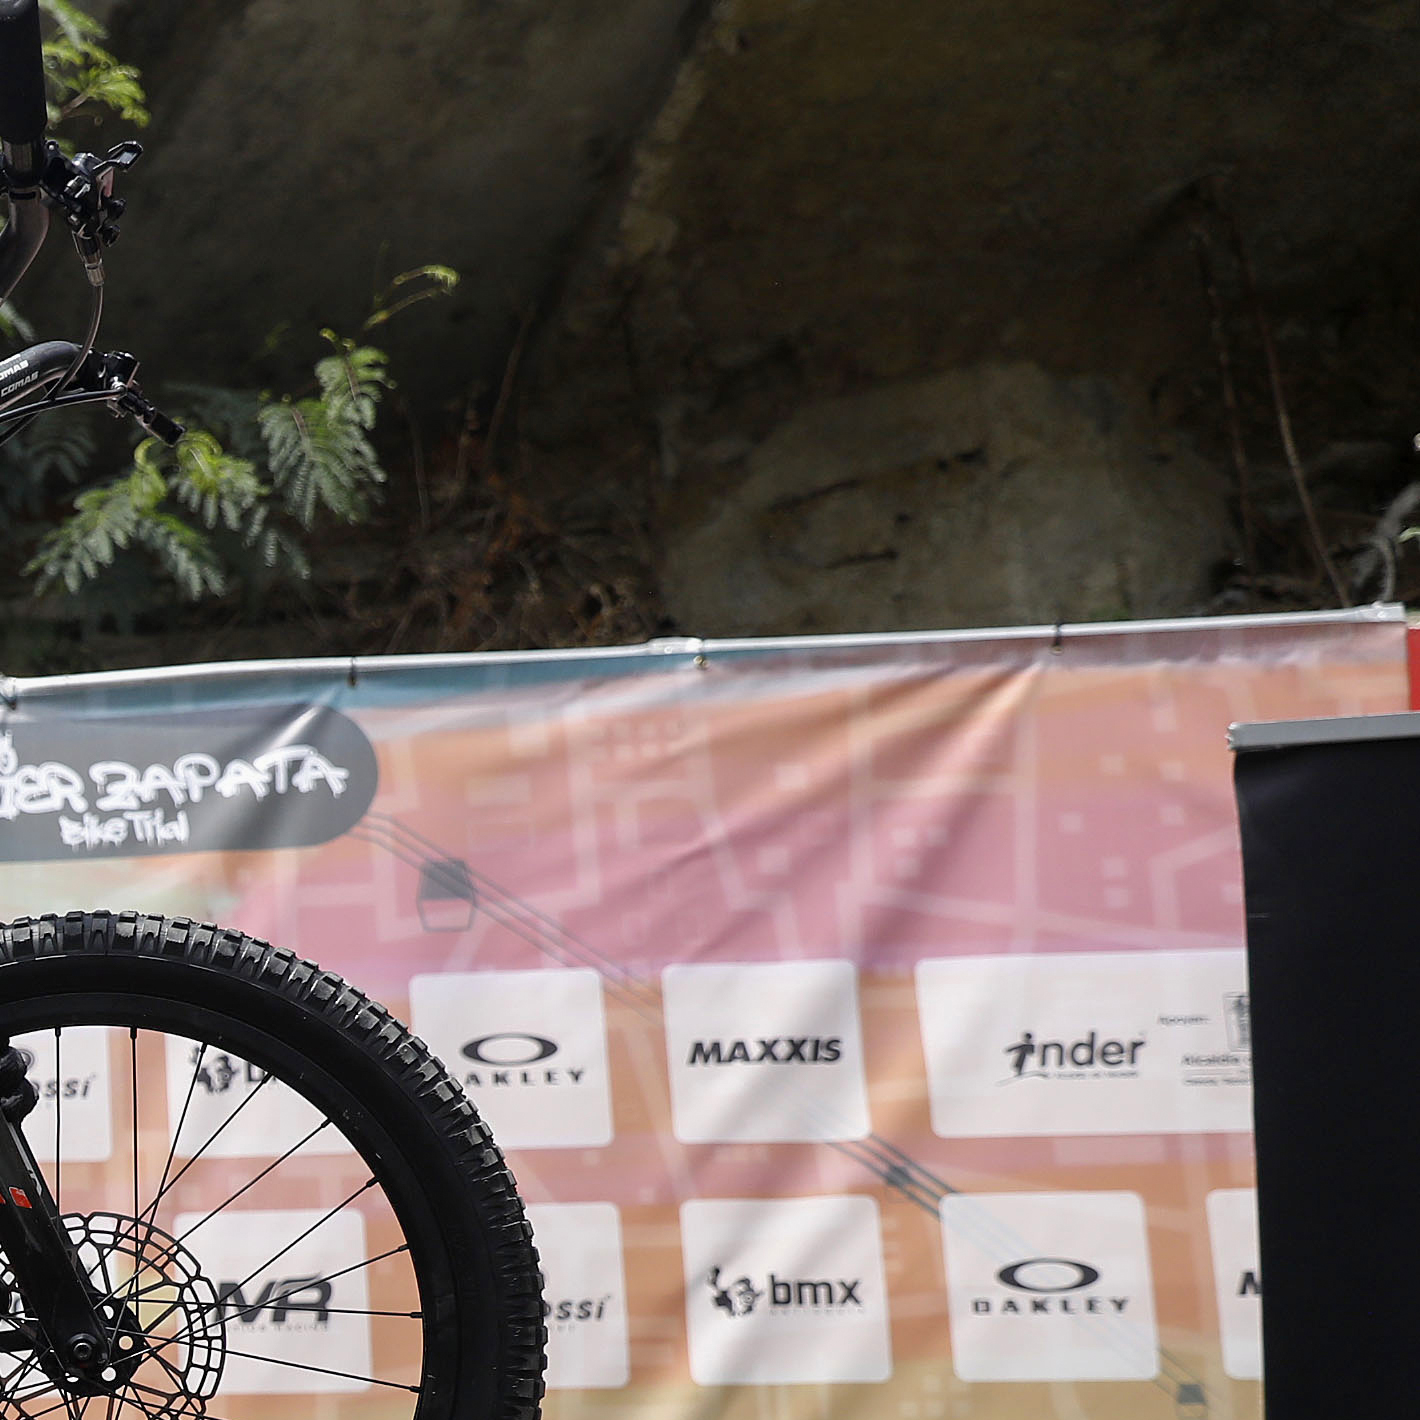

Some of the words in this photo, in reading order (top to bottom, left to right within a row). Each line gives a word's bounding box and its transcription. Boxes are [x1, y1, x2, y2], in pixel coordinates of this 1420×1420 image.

[689, 1037, 843, 1066] MAXXIS
[464, 1068, 587, 1087] AKLEY
[770, 1274, 861, 1308] bmx
[971, 1298, 1129, 1315] OAKLEY
